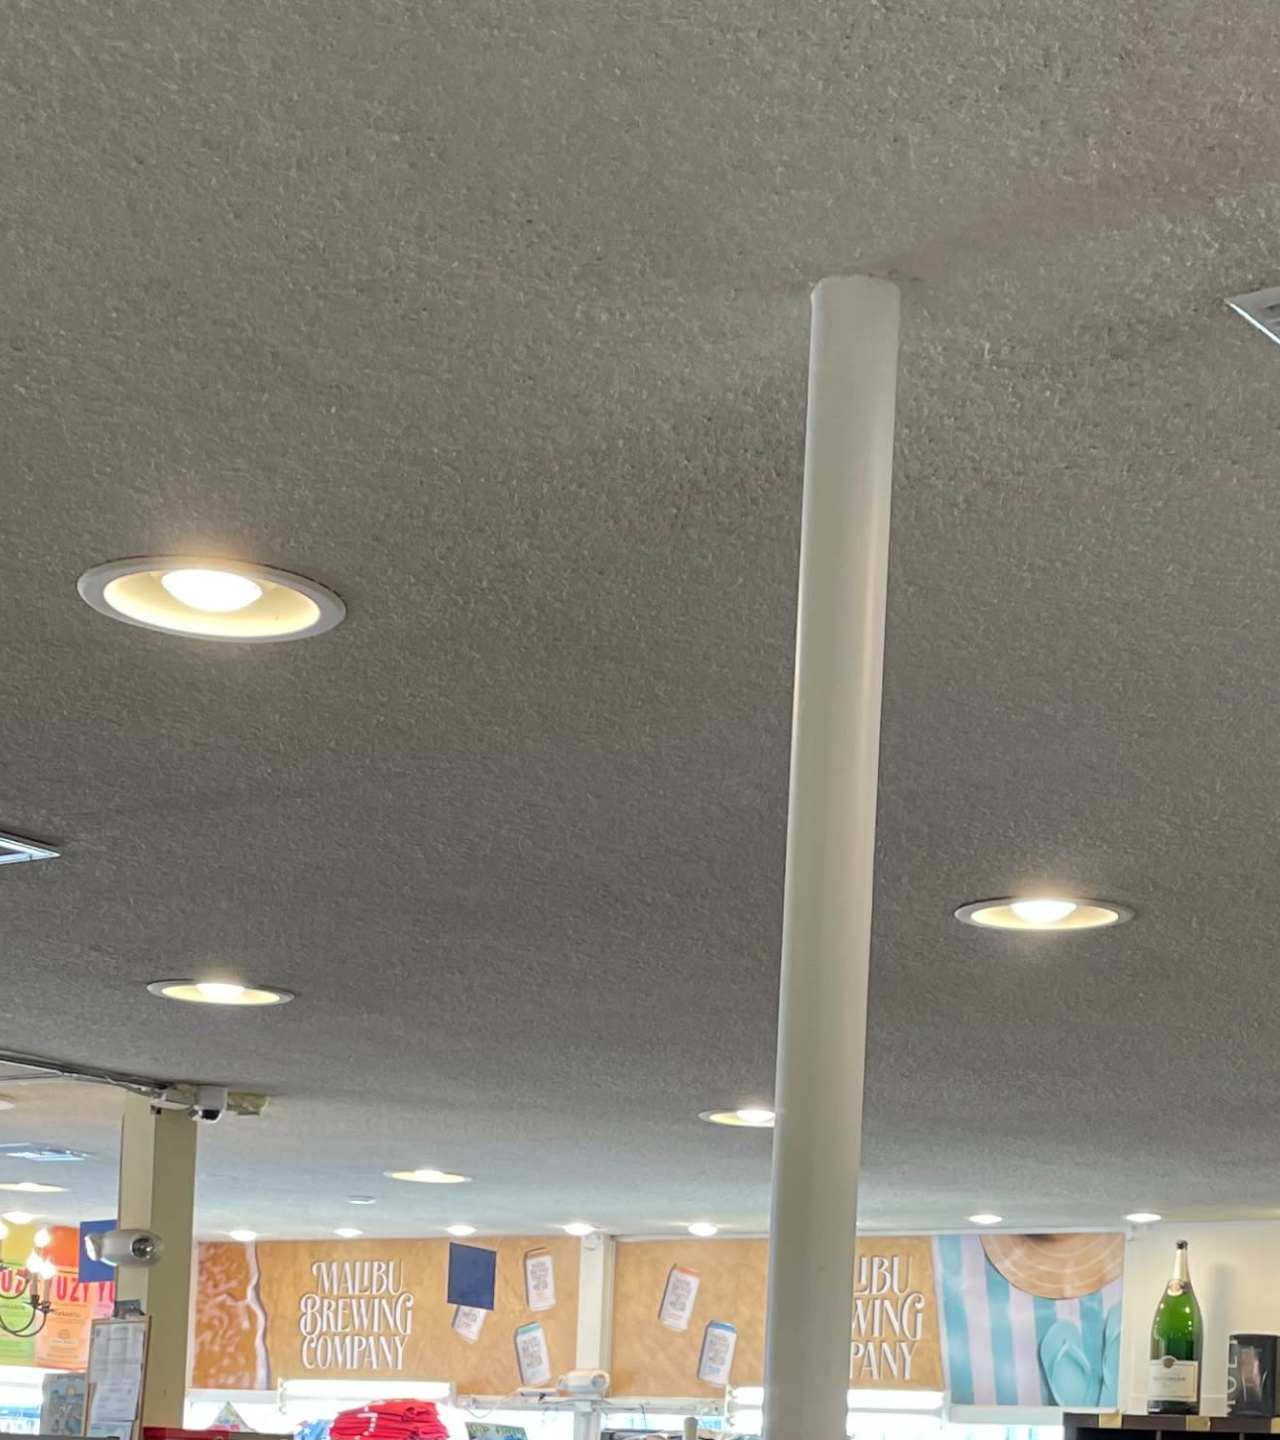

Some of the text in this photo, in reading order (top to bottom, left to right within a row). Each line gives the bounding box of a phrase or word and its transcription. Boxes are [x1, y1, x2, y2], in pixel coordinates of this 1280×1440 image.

[311, 1260, 405, 1296] MALIBU
[299, 1293, 415, 1338] BREWING
[851, 1294, 925, 1341] WING
[302, 1335, 409, 1370] COMPANY
[850, 1341, 919, 1382] PANY
